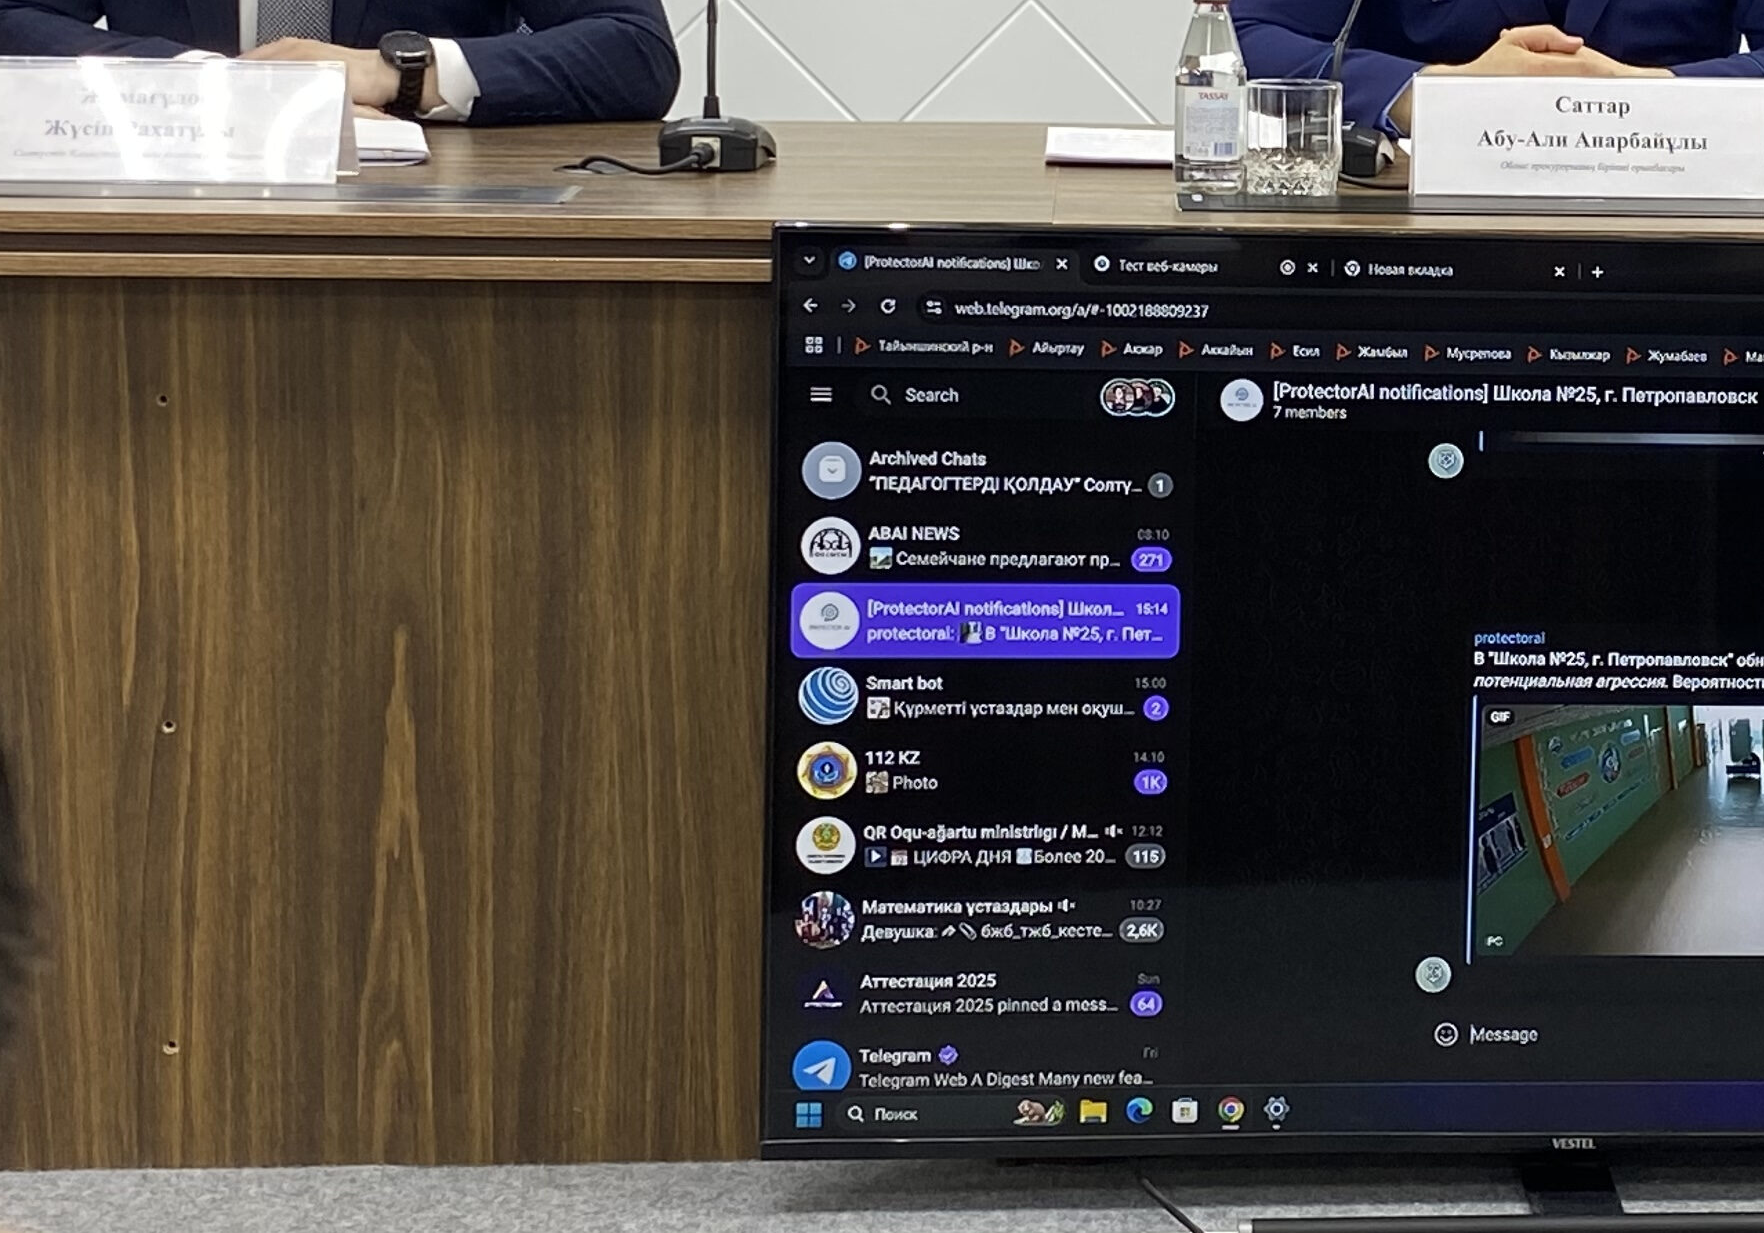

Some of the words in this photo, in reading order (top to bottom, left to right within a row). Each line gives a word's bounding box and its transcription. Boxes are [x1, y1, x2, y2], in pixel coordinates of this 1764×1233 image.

[1555, 96, 1631, 118] Саттар
[1477, 130, 1568, 153] Абу-Али
[937, 256, 1011, 270] notifications]
[1119, 259, 1145, 272] Тест
[1147, 261, 1218, 274] веб-камеры
[1368, 263, 1405, 276] Новая
[1407, 264, 1453, 278] вкладка
[971, 342, 993, 356] р-н
[1032, 340, 1085, 357] Айыртау
[1293, 344, 1320, 358] Есил
[1358, 345, 1408, 359] Жамбыл
[1648, 349, 1707, 364] Жумабаев
[905, 387, 959, 403] Search
[1273, 380, 1375, 401] [ProtectorAI
[1379, 382, 1489, 404] notifications]
[1493, 385, 1552, 402] Школа
[1556, 385, 1601, 405] №25,
[1604, 390, 1618, 403] г.
[1622, 387, 1759, 406] Петропавловск
[1273, 406, 1281, 419] 7
[1285, 406, 1347, 420] members
[869, 451, 937, 466] Archived
[942, 451, 986, 466] Chats
[1004, 477, 1081, 495] ҚОЛДАУ"
[868, 527, 908, 541] ABAI
[912, 527, 960, 541] NEWS
[896, 551, 986, 567] Семейчане
[990, 552, 1087, 570] предлагают
[1139, 553, 1163, 566] 271
[867, 601, 961, 619] [ProtectorAI
[965, 600, 1064, 619] notifications]
[1136, 602, 1169, 616] 15:14
[1000, 626, 1059, 642] "Школа
[1063, 626, 1103, 644] №25,
[1488, 651, 1545, 666] "Школа
[1549, 651, 1589, 669] №25,
[1608, 652, 1734, 669] Петропавловск"
[866, 677, 914, 691] Smart
[917, 676, 943, 691] bot
[1135, 677, 1167, 689] 15:00
[1473, 674, 1591, 690] потенциальная
[1595, 675, 1668, 691] агрессия.
[970, 704, 1043, 720] ұстаздар
[1047, 704, 1078, 716] мен
[1152, 702, 1161, 715] 2
[1490, 711, 1511, 723] GIF
[866, 751, 895, 765] 112
[898, 751, 921, 765] KZ
[893, 776, 938, 790] Photo
[1142, 777, 1161, 790] 1K
[863, 825, 886, 841] QR
[891, 824, 977, 843] Oqu-ağartu
[1132, 825, 1163, 837] 12:12
[914, 850, 971, 866] ЦИФРА
[975, 850, 1012, 866] ДНЯ
[1034, 849, 1081, 864] Более
[861, 900, 962, 915] Математика
[965, 901, 1053, 918] ұстаздары
[1130, 899, 1162, 911] 10:27
[861, 925, 938, 942] Девушка:
[1126, 924, 1158, 939] 2,6K
[860, 974, 954, 991] Аттестация
[957, 974, 996, 988] 2025
[1138, 973, 1160, 985] Sun
[860, 999, 951, 1015] Аттестация
[955, 998, 994, 1013] 2025
[997, 998, 1049, 1015] pinned
[1052, 1002, 1061, 1012] a
[1138, 998, 1155, 1012] 64
[1470, 1025, 1539, 1045] Message
[859, 1049, 931, 1065] Telegram
[859, 1073, 930, 1089] Telegram
[934, 1073, 967, 1087] Web
[987, 1072, 1036, 1089] Digest
[1039, 1073, 1079, 1089] Many
[1084, 1075, 1115, 1086] new
[874, 1108, 918, 1121] Поиск
[1552, 1138, 1597, 1150] VESTEL
